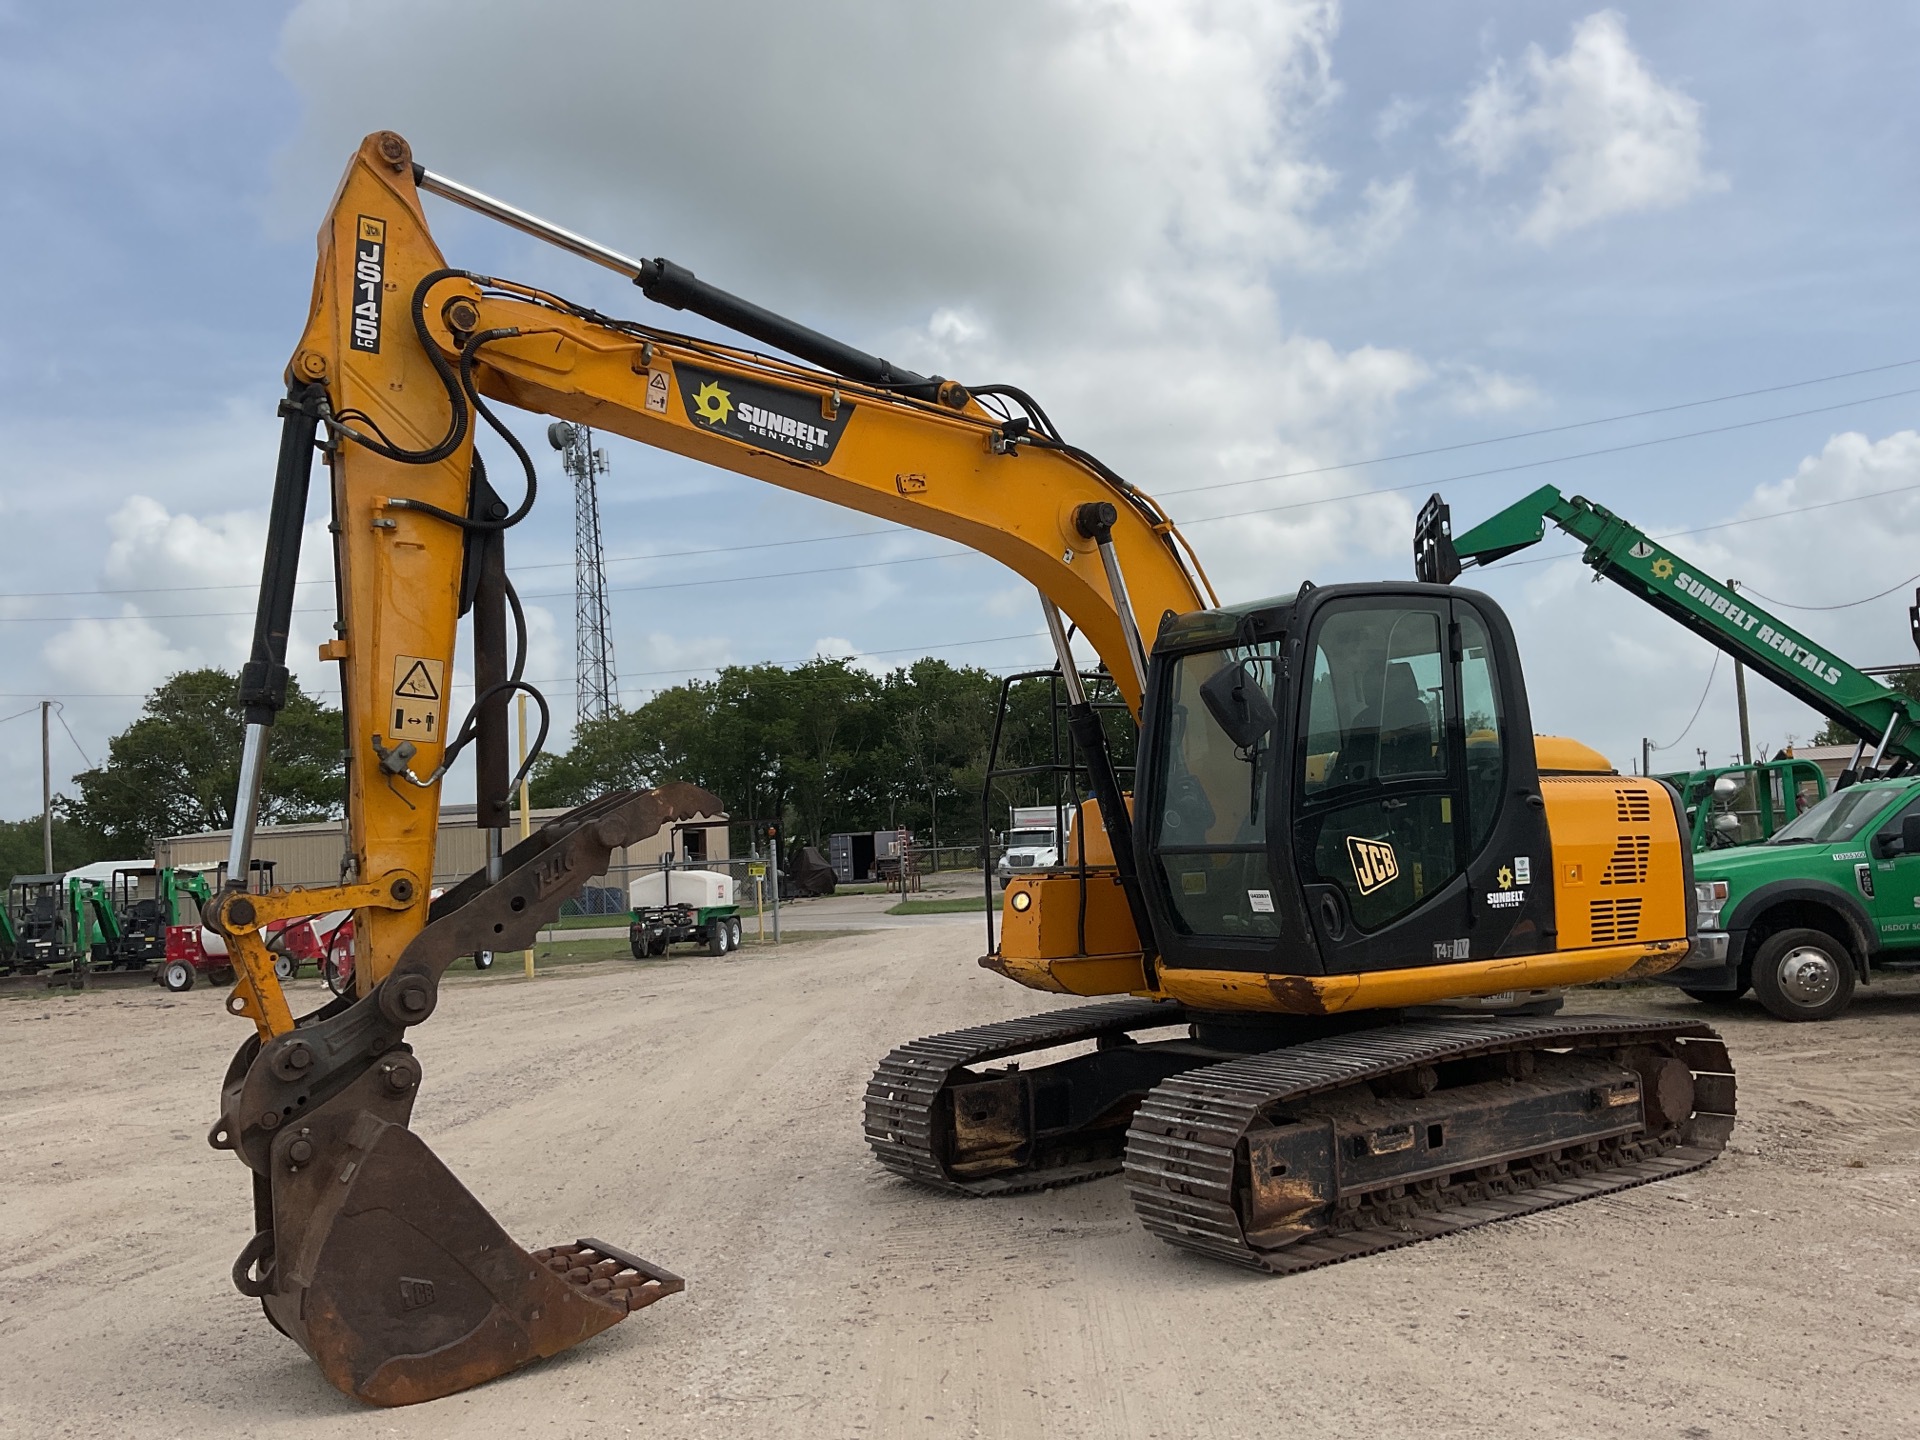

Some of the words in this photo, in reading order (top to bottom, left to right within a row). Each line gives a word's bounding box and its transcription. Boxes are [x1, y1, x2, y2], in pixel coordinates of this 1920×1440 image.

[355, 244, 381, 340] JS145
[357, 338, 374, 348] LC
[737, 402, 828, 448] SUNBELT
[749, 424, 813, 451] RENTALS
[1673, 571, 1760, 632] SUNBELT
[1756, 623, 1843, 686] RENTALS
[1355, 842, 1396, 887] JCB
[1486, 890, 1524, 905] SUNBELT
[1491, 901, 1519, 909] RENTALS
[1881, 924, 1910, 932] USDOT
